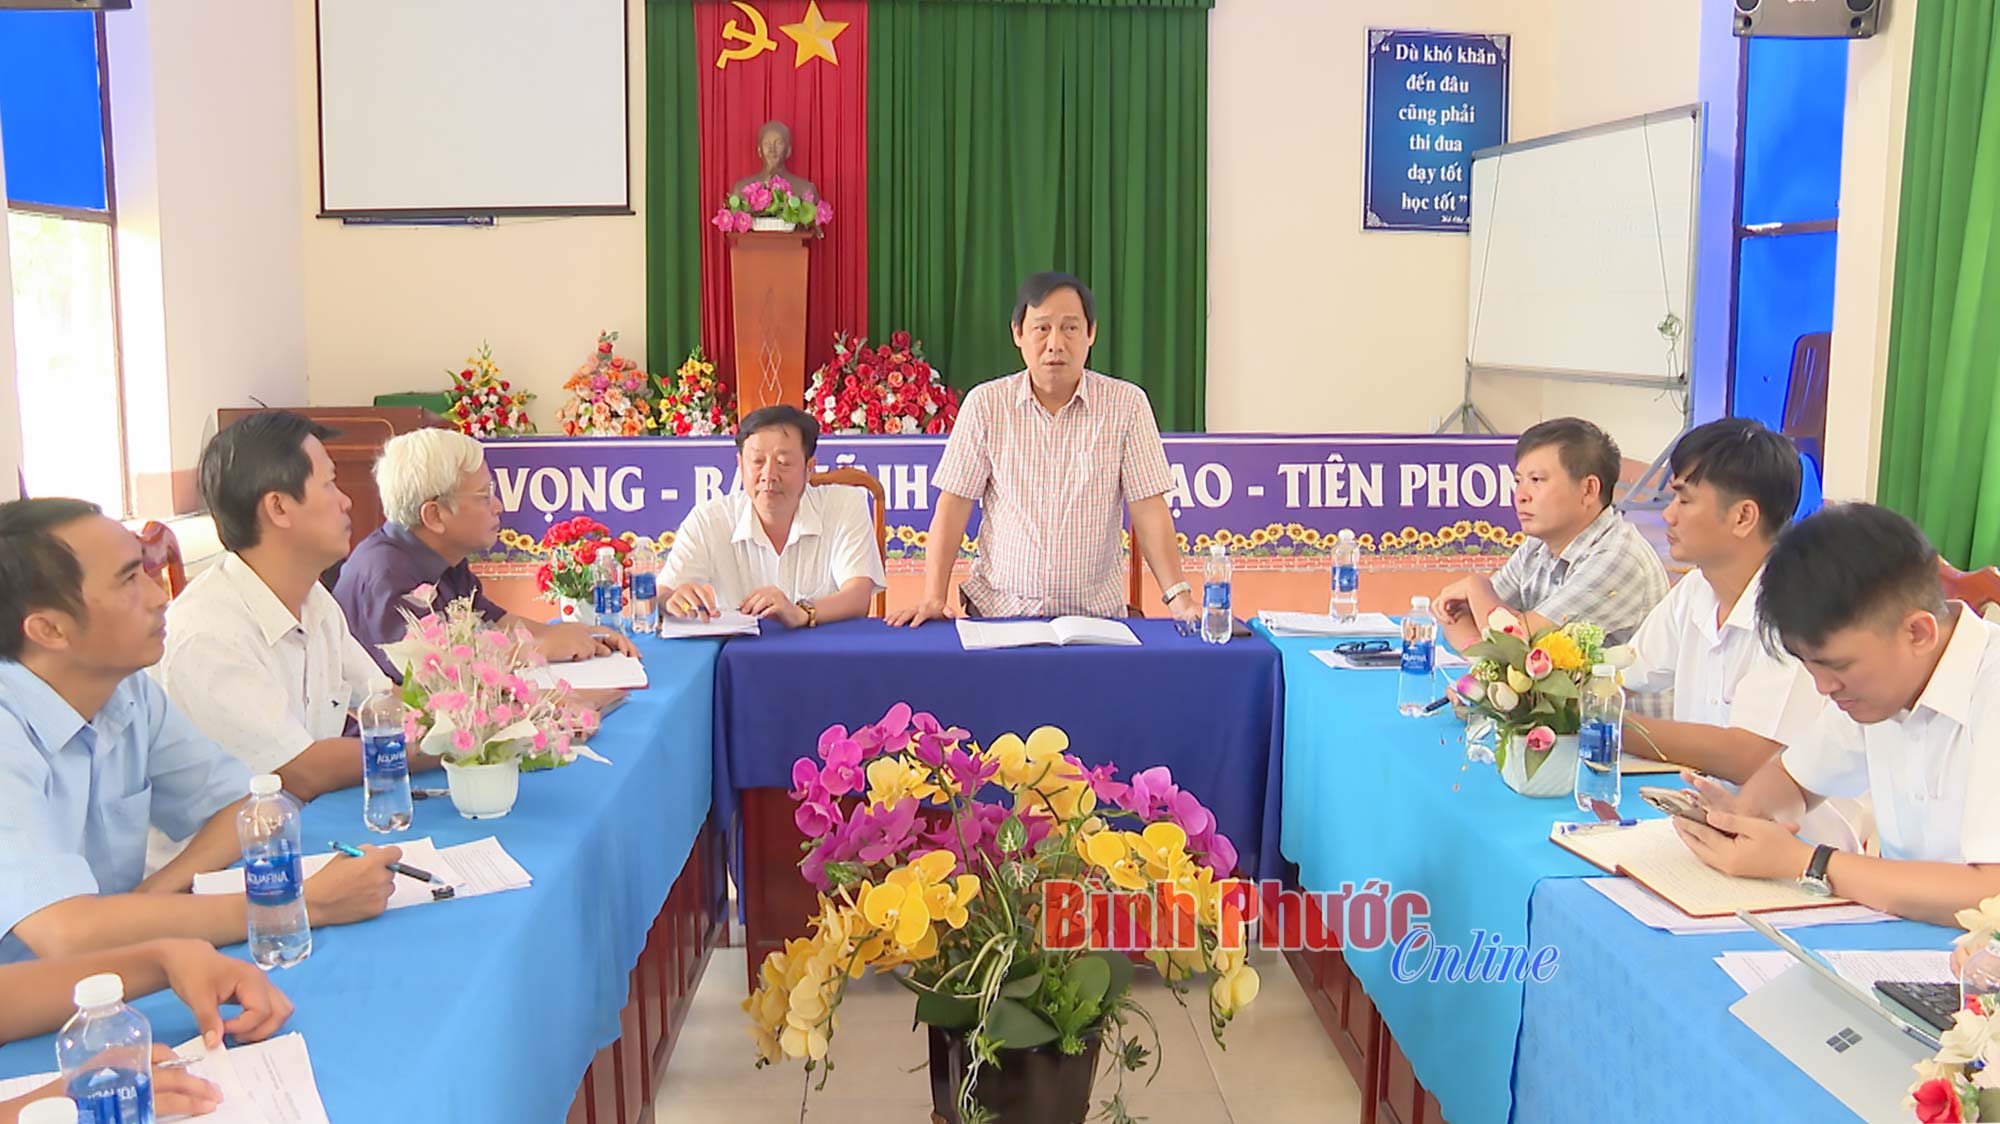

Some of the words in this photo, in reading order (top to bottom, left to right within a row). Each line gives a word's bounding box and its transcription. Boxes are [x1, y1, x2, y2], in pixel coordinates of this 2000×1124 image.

[1395, 43, 1419, 61] Dù
[1423, 44, 1452, 62] khó
[1457, 45, 1497, 65] khăn
[1406, 72, 1436, 92] đến
[1440, 75, 1469, 93] đâu
[1398, 104, 1437, 125] cũng
[1440, 103, 1475, 125] phải
[1409, 134, 1430, 151] thi
[1434, 134, 1463, 152] đua
[1407, 163, 1436, 184] dạy
[1440, 162, 1463, 181] tốt
[1401, 192, 1429, 213] học
[494, 466, 645, 523] VỌNG
[1162, 463, 1233, 519] ẠO
[1277, 453, 1384, 508] TIÊN
[1400, 463, 1517, 508] PHON
